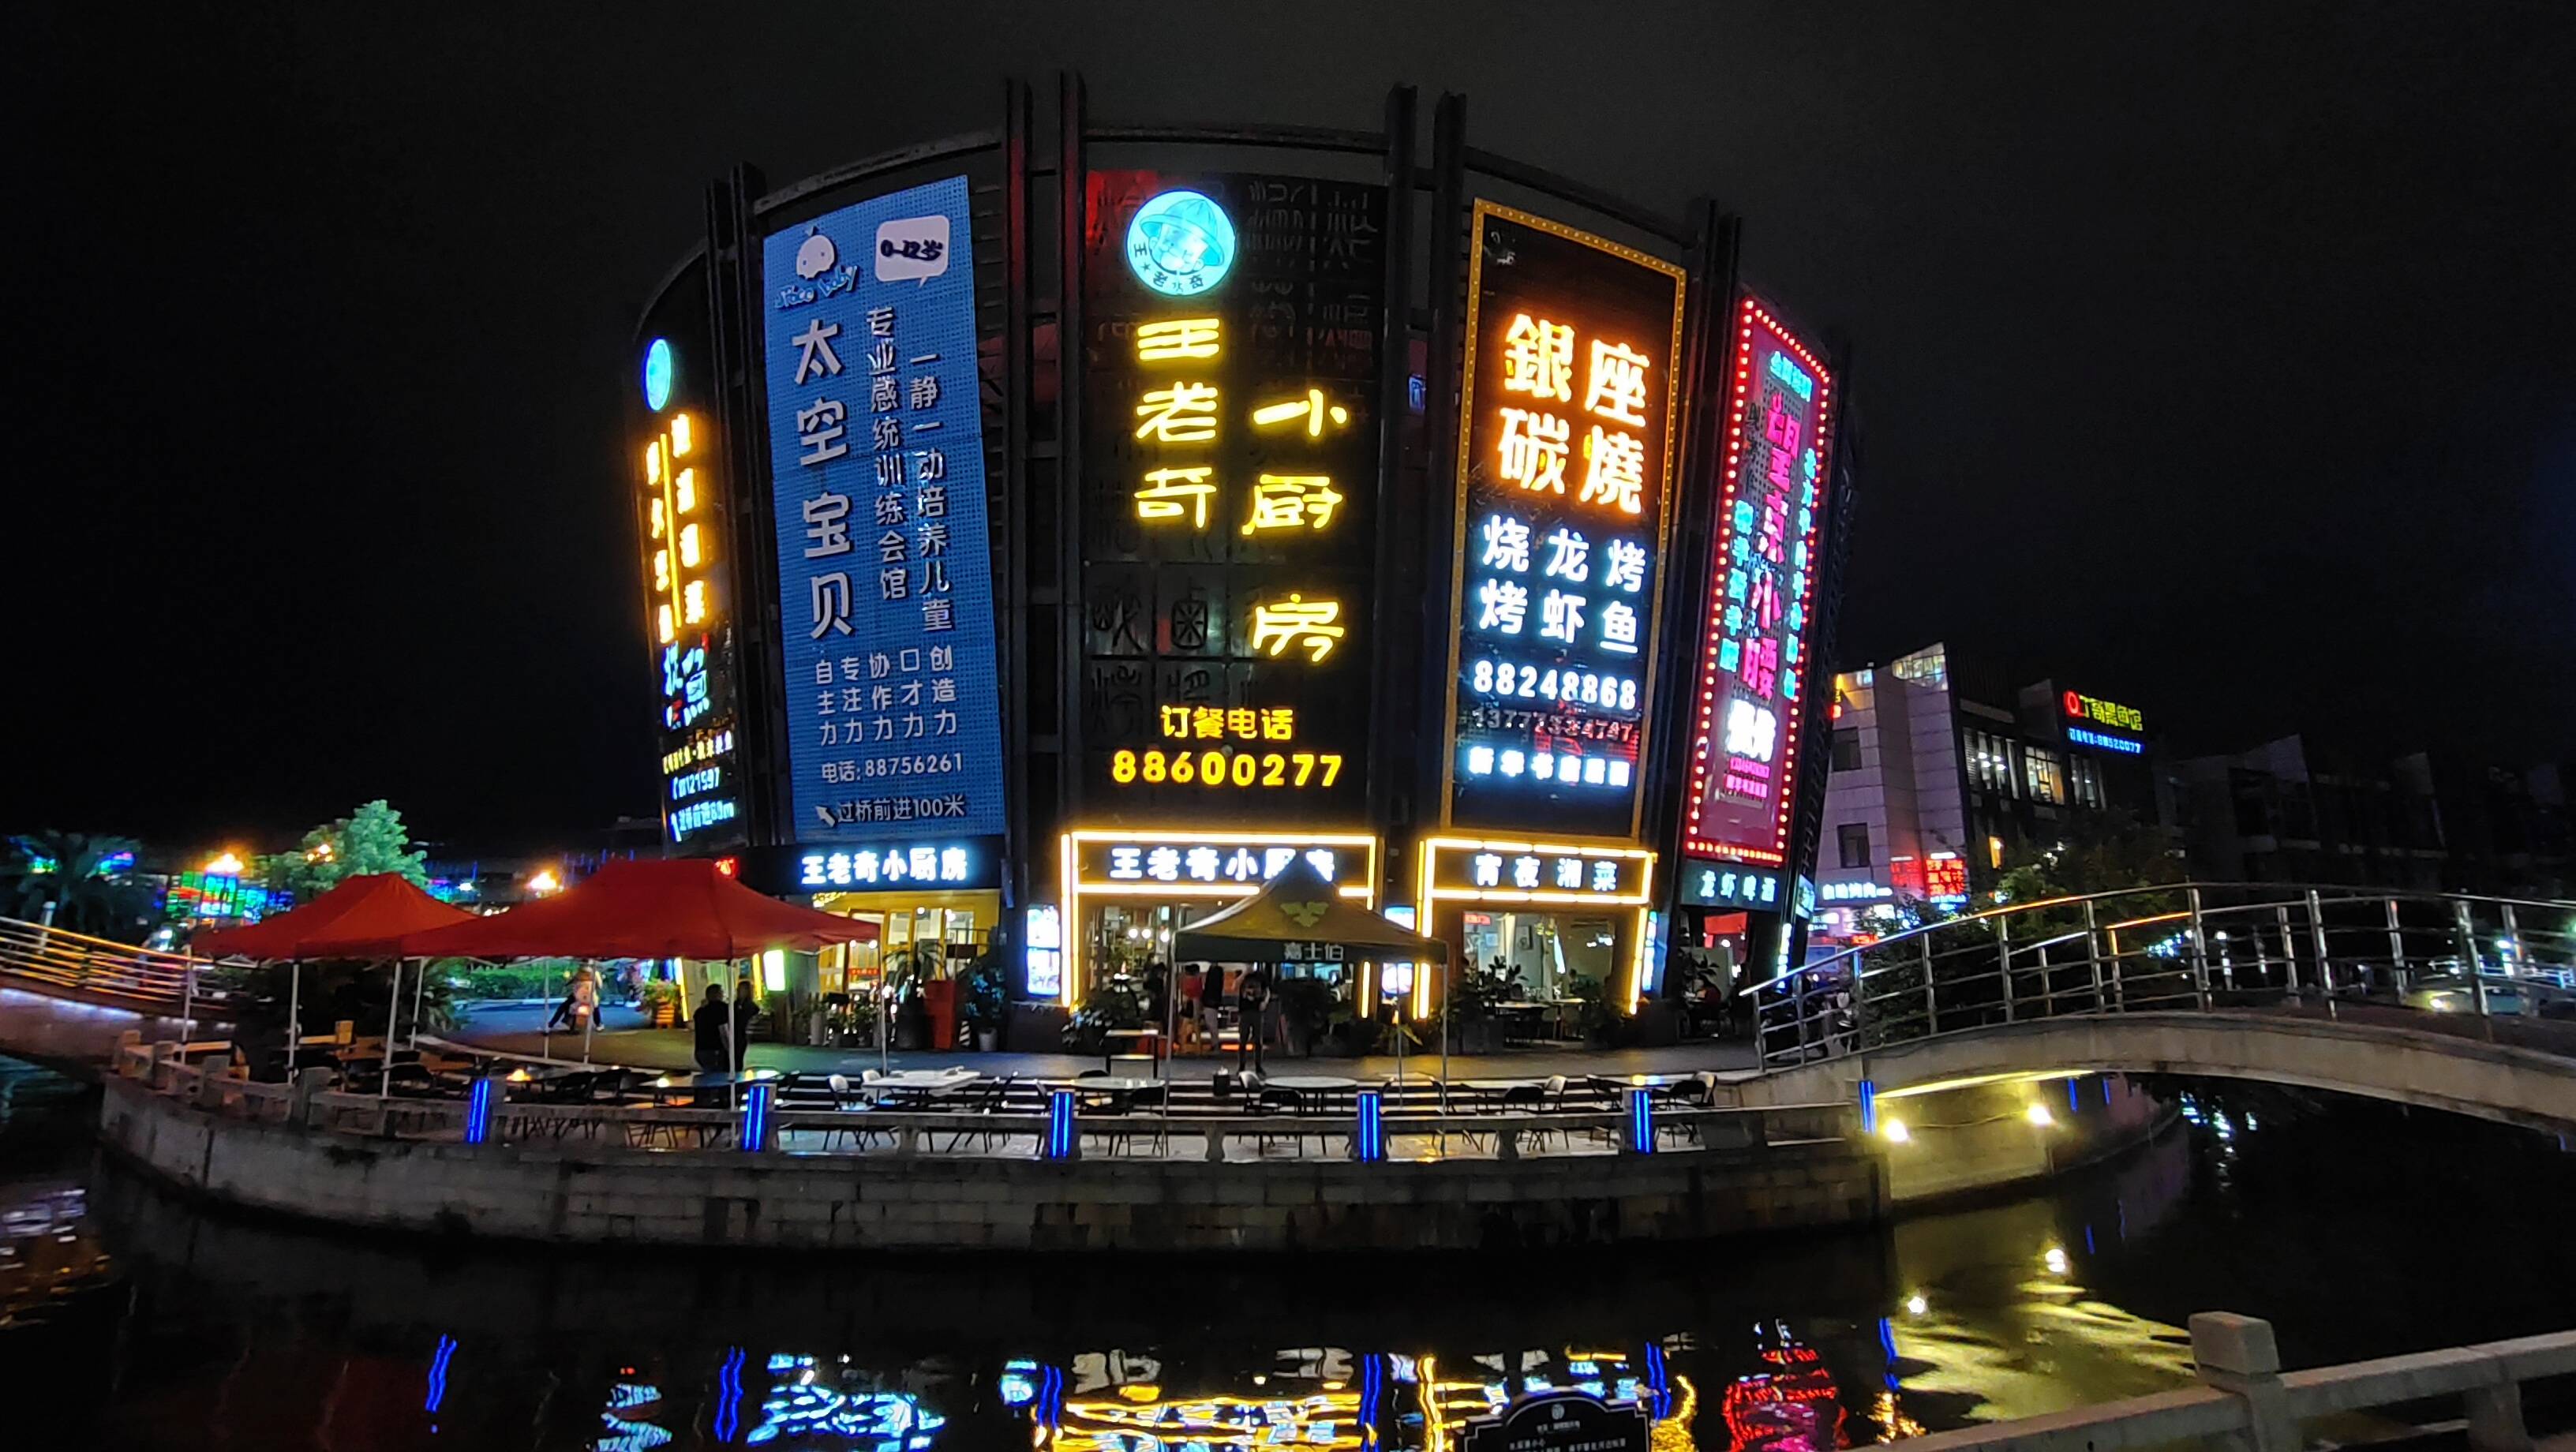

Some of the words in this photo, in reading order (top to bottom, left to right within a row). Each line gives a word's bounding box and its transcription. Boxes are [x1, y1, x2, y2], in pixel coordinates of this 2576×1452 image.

[880, 239, 944, 261] 0-12岁
[1504, 313, 1650, 428] 銀座
[867, 305, 907, 600] 专业感统训练会馆
[1136, 318, 1220, 528] 王老奇
[1497, 406, 1646, 515] 碳燒
[792, 318, 852, 639] 太空宝贝
[909, 352, 953, 632] 一静一动培养儿童
[1242, 389, 1348, 662] 小厨房
[1478, 515, 1531, 634] 烧烤
[1540, 527, 1589, 643] 龙虾
[1599, 538, 1647, 654] 烤鱼
[815, 659, 838, 747] 自主力
[840, 656, 863, 744] 专注力
[869, 652, 893, 741] 协作力
[899, 648, 923, 738] 口才力
[930, 644, 957, 735] 创造力
[1160, 705, 1295, 740] 订餐电话
[1473, 660, 1637, 710] 88248868
[837, 794, 965, 823] 过桥前进100米
[1112, 750, 1342, 787] 88600277
[801, 847, 968, 885] 王老奇小厨房
[1283, 941, 1343, 960] 嘉士伯
